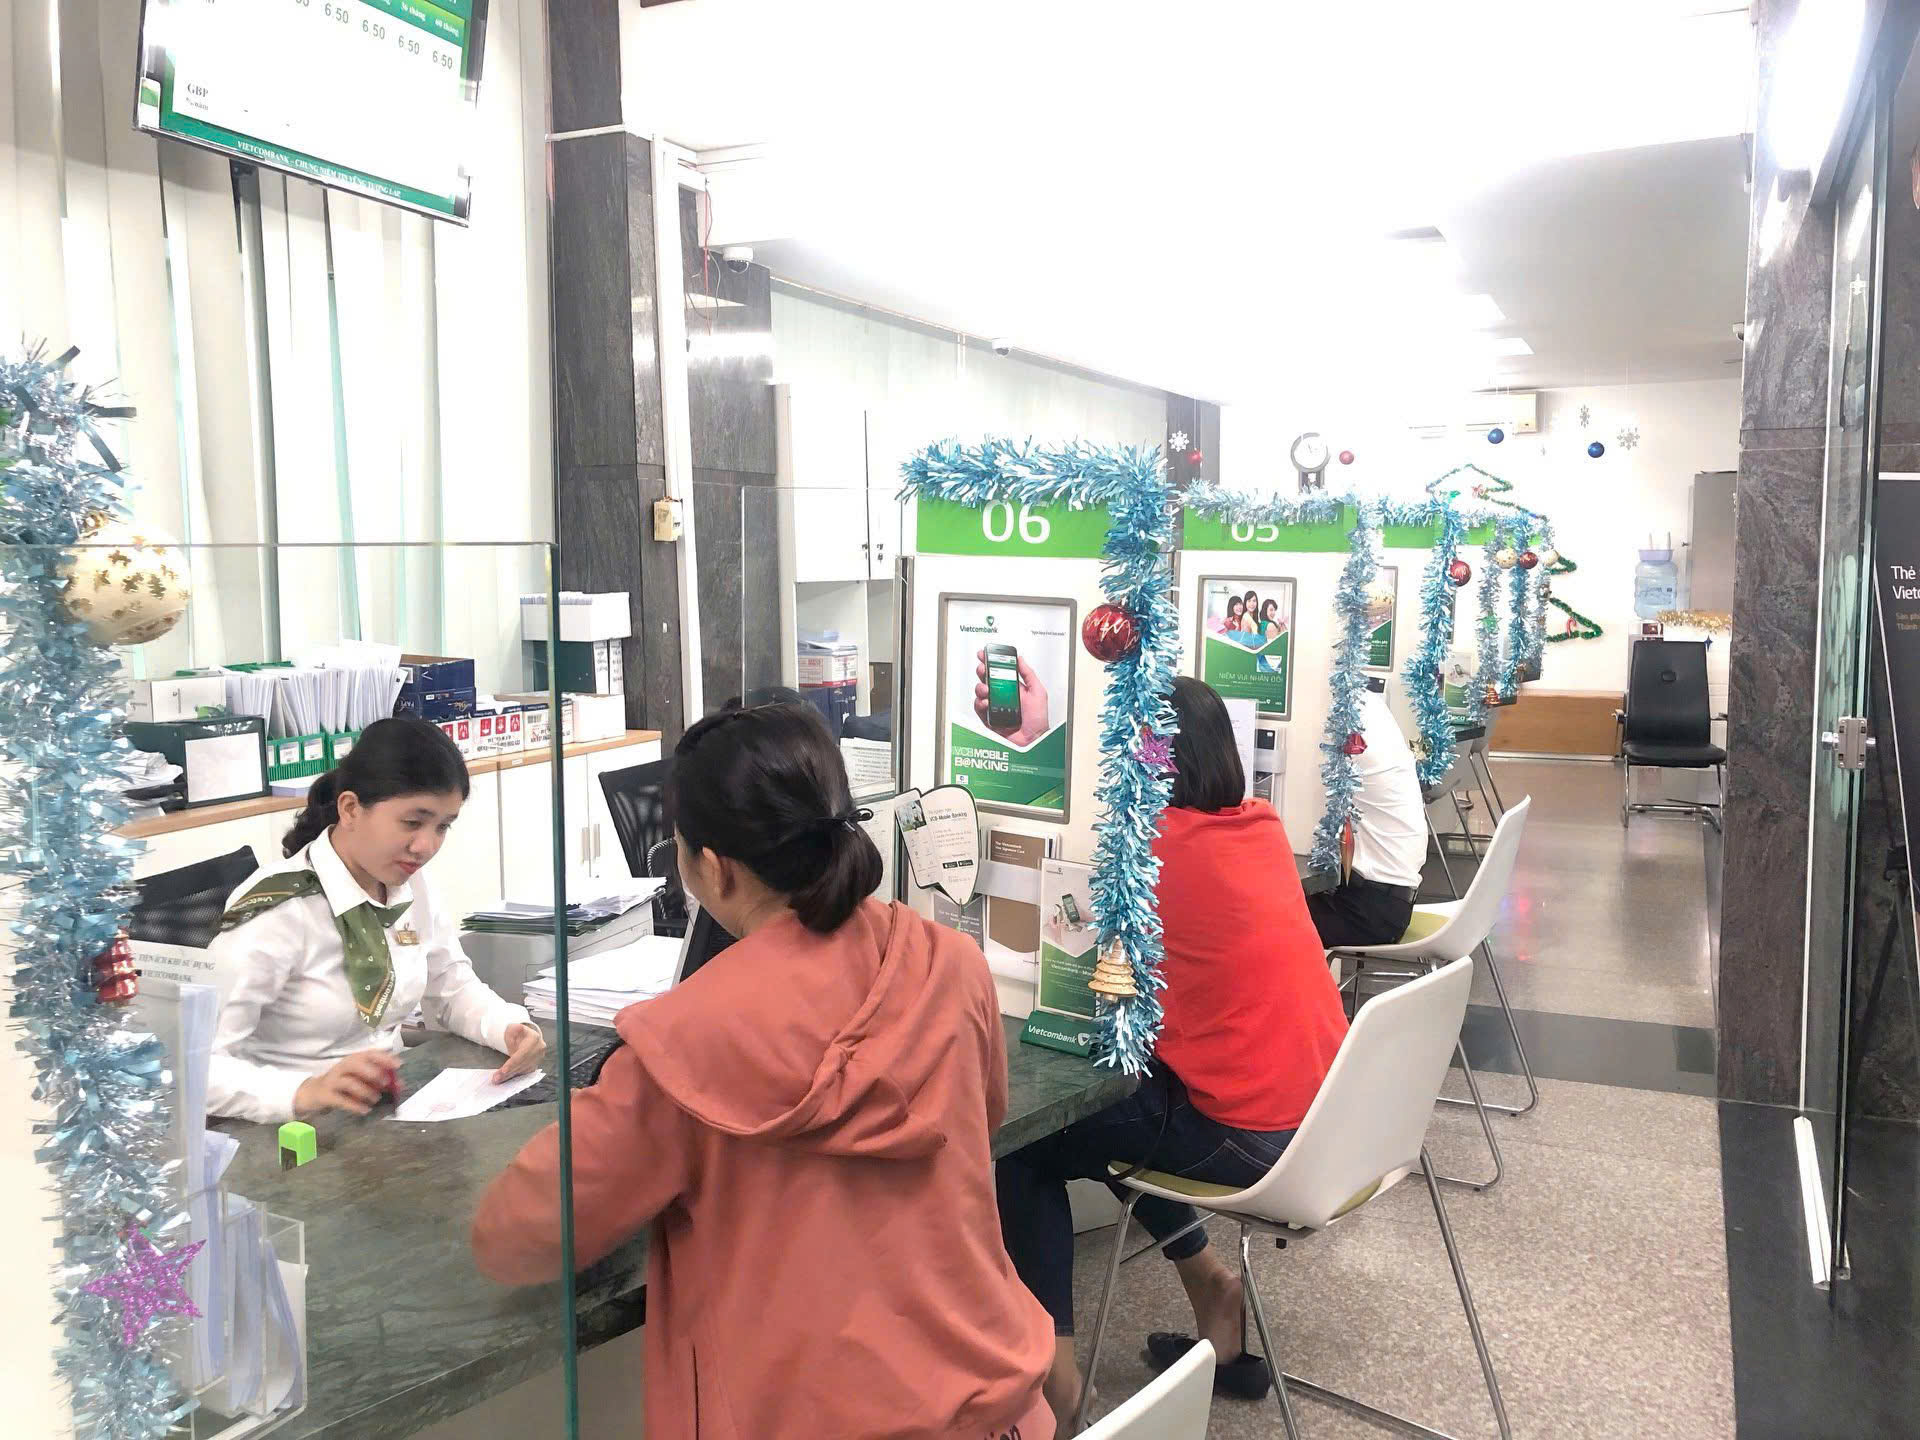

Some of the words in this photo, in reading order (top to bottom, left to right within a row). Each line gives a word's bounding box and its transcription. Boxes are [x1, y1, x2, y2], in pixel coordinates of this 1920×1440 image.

[187, 83, 209, 98] GBP
[981, 500, 1051, 544] 06
[1890, 565, 1917, 580] Thẻ
[960, 624, 998, 634] Vietcombank
[974, 748, 1010, 761] MOBILE
[954, 756, 1009, 772] B@NKING
[1028, 1024, 1078, 1044] Vietcombank
